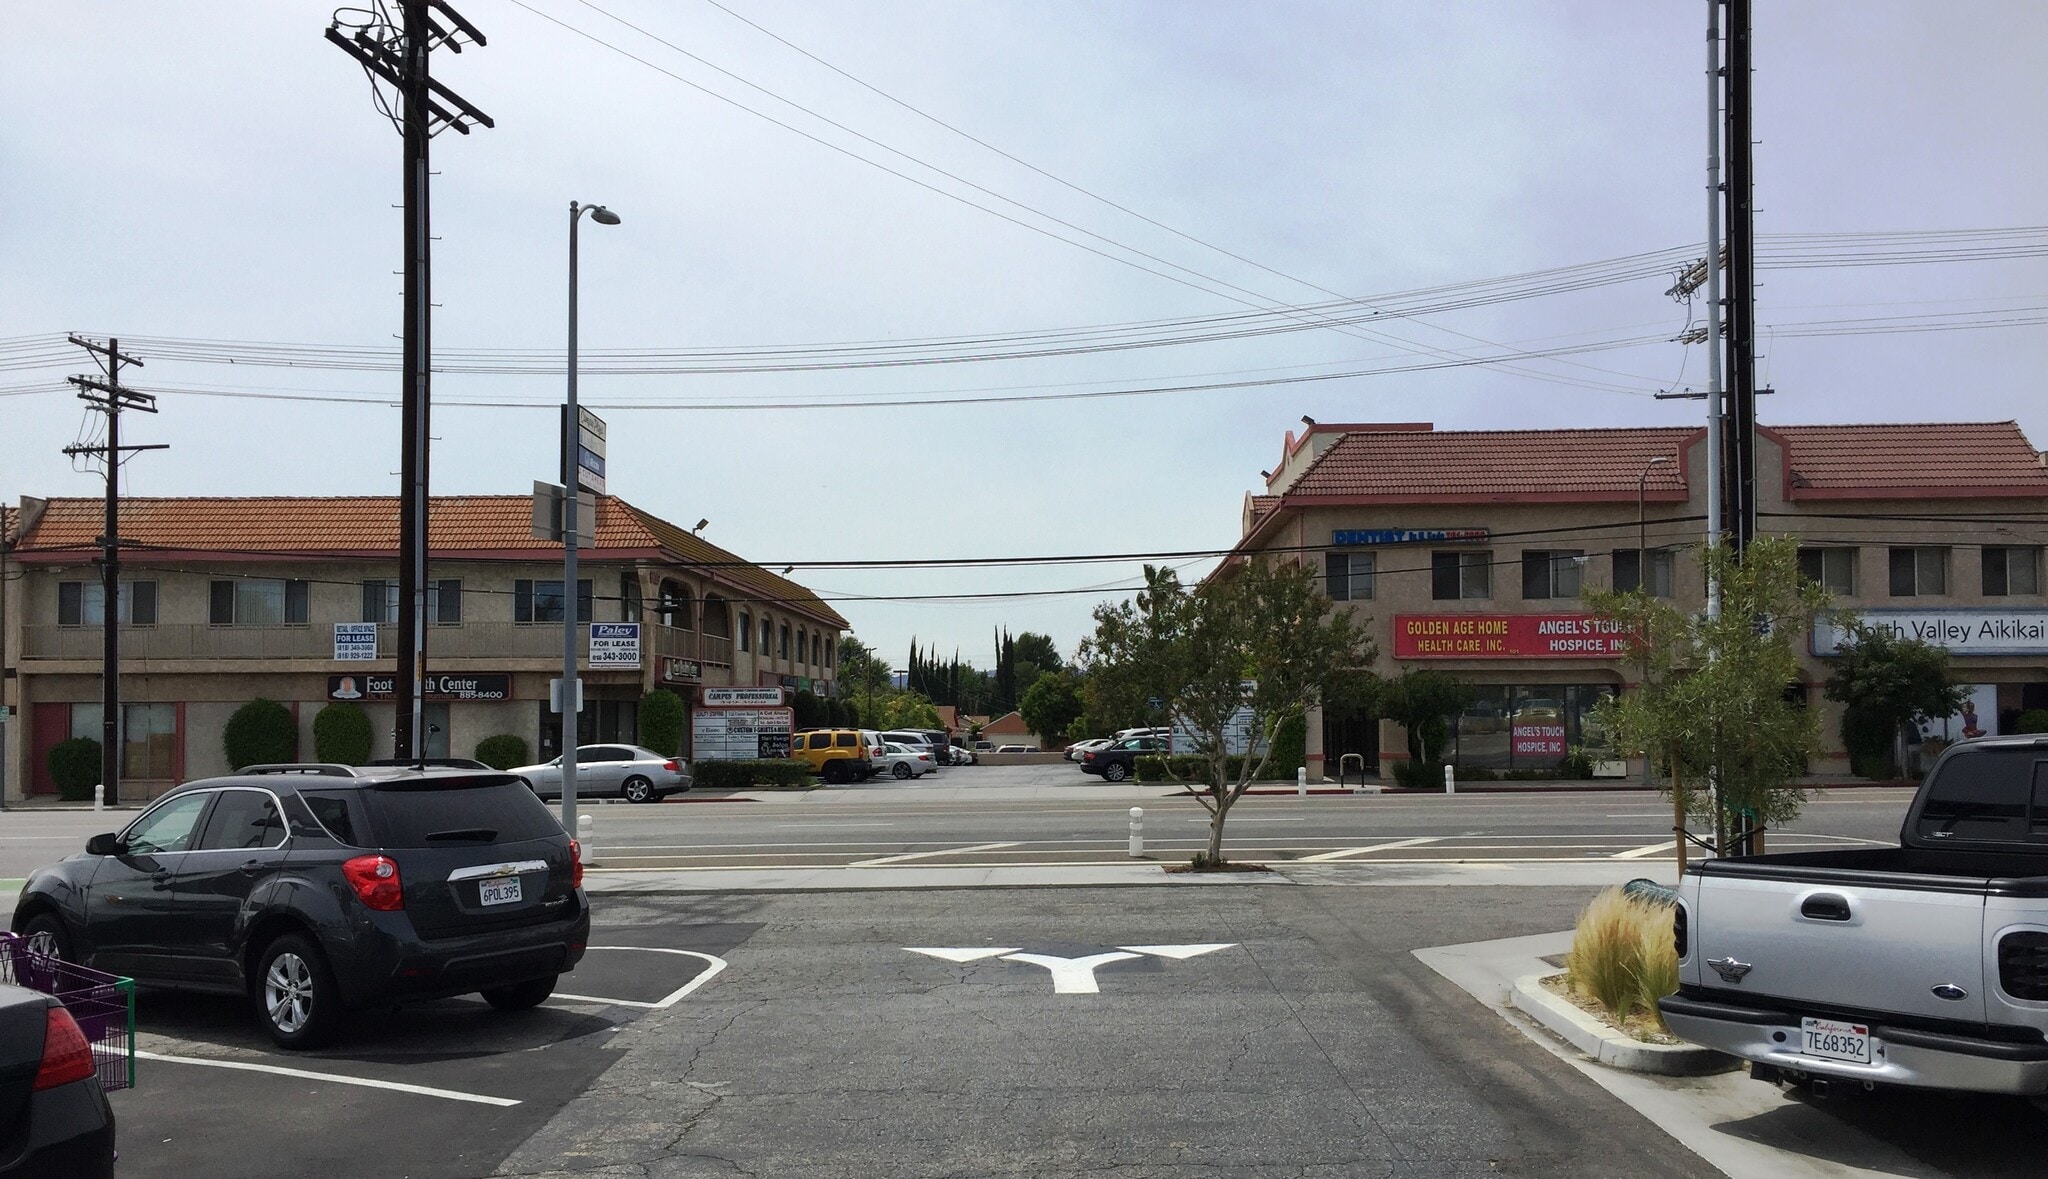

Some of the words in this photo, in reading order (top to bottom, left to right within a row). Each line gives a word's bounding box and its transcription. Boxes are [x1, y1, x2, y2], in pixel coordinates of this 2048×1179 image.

[1334, 530, 1405, 545] DENTIST
[598, 625, 632, 636] Paley
[1407, 621, 1449, 635] GOLDEN
[1453, 621, 1474, 635] AGE
[1478, 621, 1508, 635] HOME
[1538, 620, 1590, 635] ANGEL'S
[1911, 620, 1972, 643] Valley
[1978, 620, 2045, 640] Aikikai
[1418, 639, 1453, 652] HEALTH
[1456, 639, 1484, 653] CARE,
[1486, 639, 1506, 652] INC.
[1550, 639, 1607, 653] HOSPICE,
[603, 652, 637, 661] 343-3000
[367, 676, 393, 693] Foot
[439, 676, 478, 693] Center
[459, 691, 503, 699] 885-8400
[1513, 726, 1540, 737] ANGEL'S
[1541, 726, 1565, 737] TOUCH
[1549, 741, 1561, 752] INC
[1815, 1021, 1853, 1034] California
[1806, 1030, 1864, 1056] 7E68352
